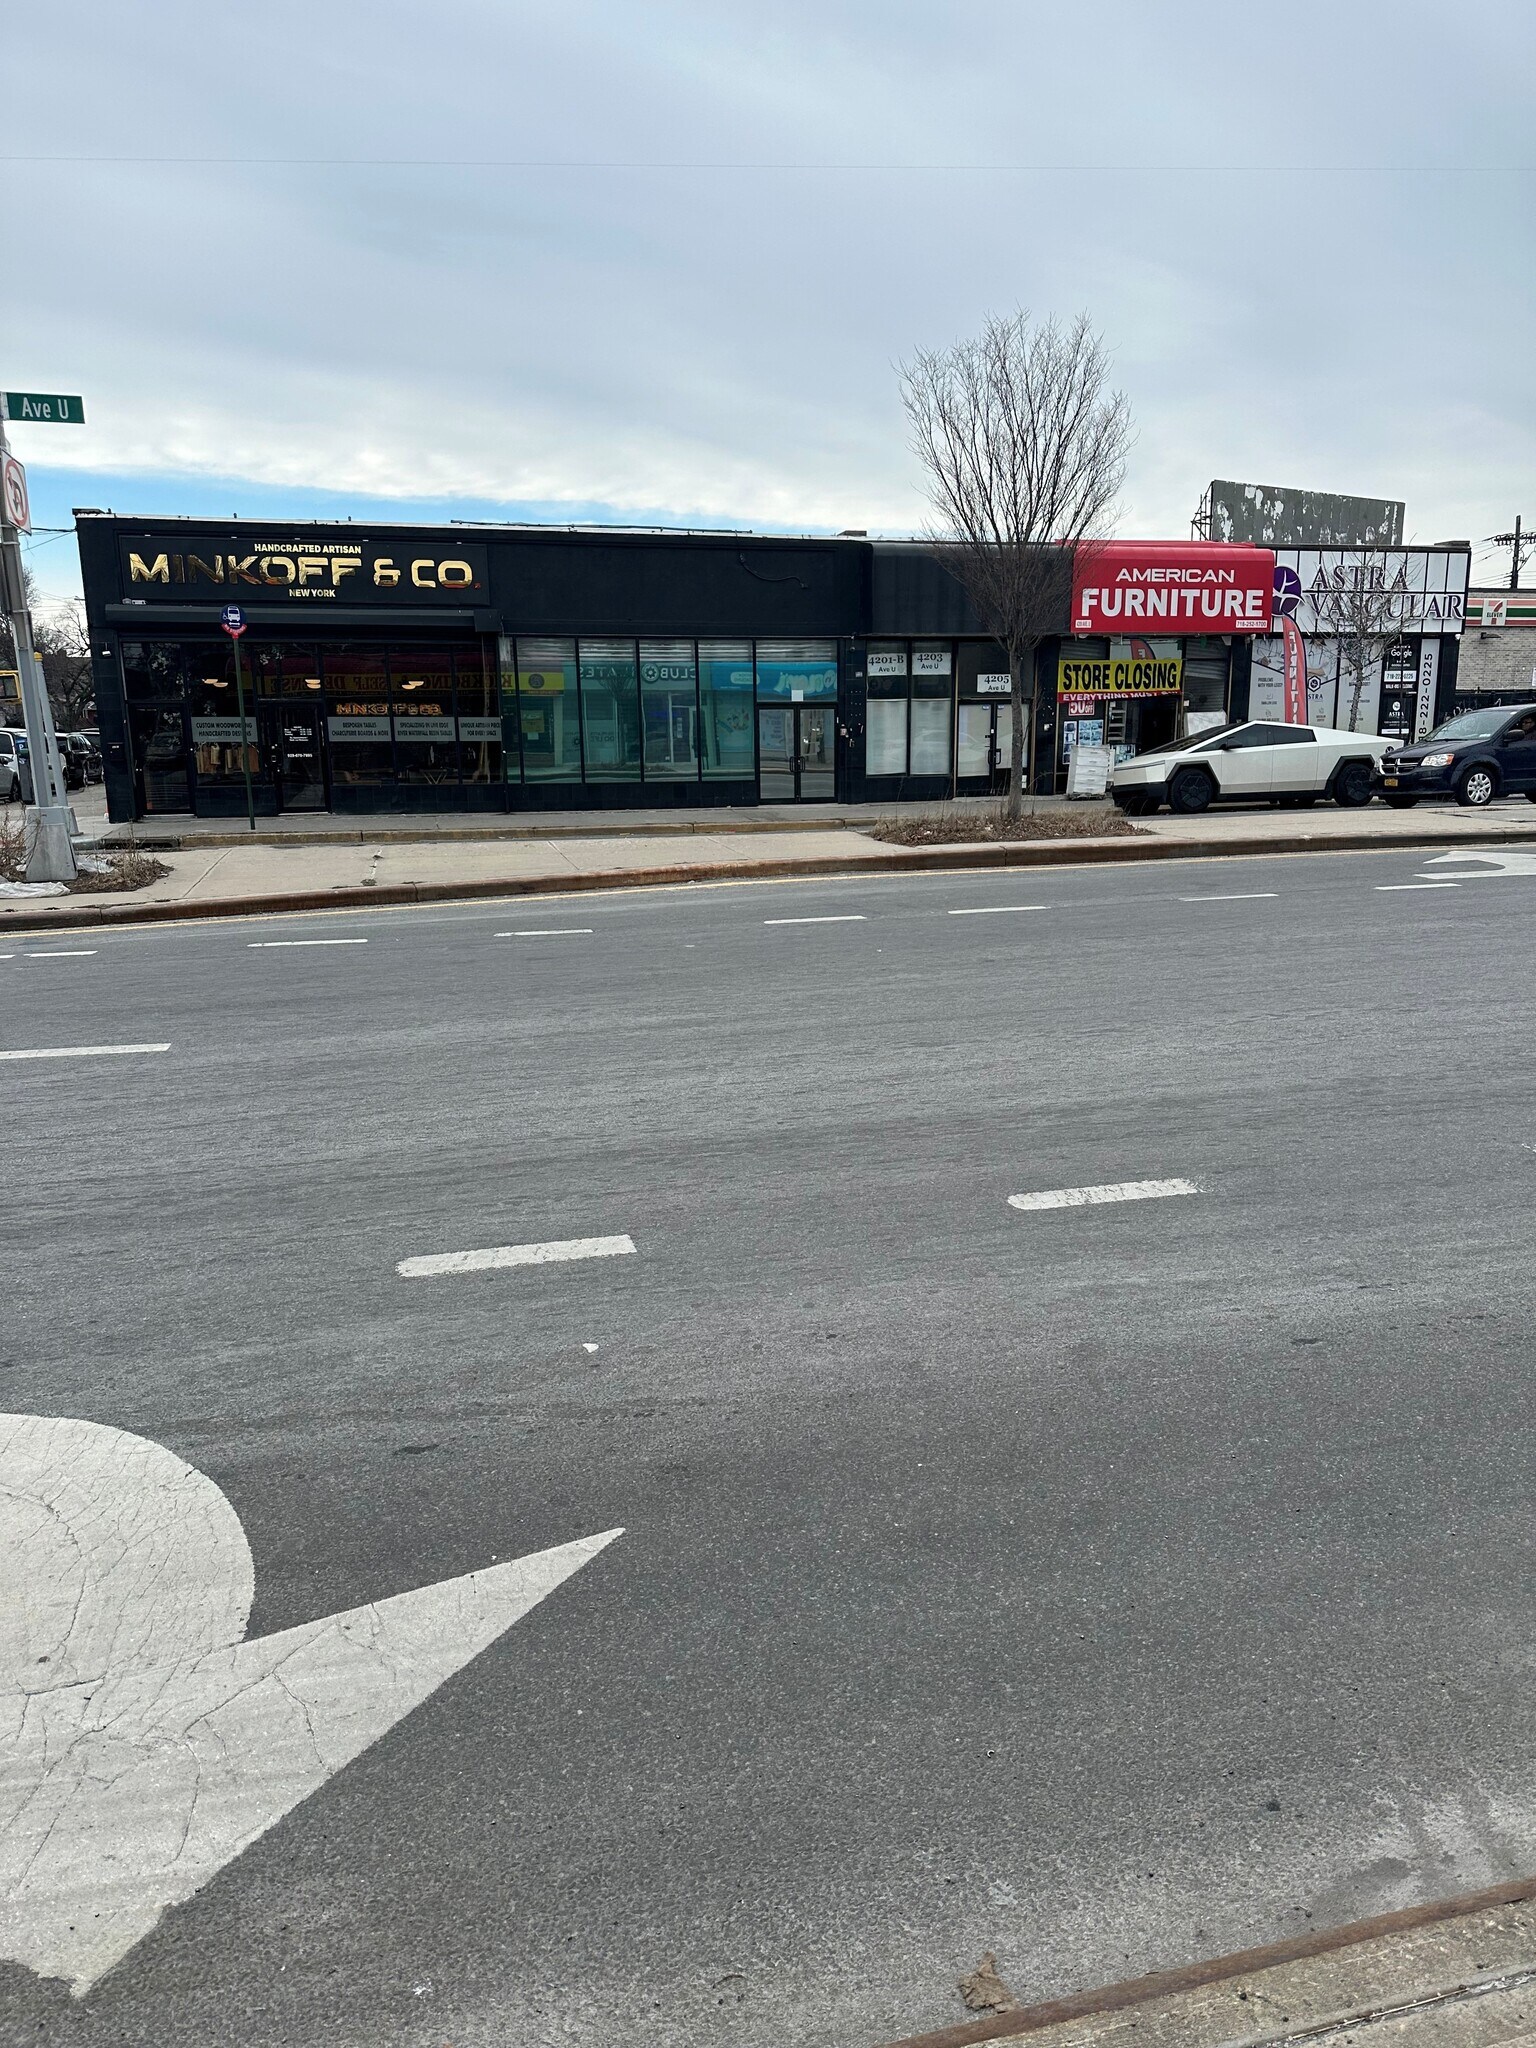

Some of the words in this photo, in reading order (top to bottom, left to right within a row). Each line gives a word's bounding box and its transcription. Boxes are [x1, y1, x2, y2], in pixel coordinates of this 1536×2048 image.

[22, 397, 51, 418] Ave
[58, 398, 69, 419] U
[254, 543, 321, 553] HANDCRAFTED
[322, 545, 362, 554] ARTISAN
[129, 553, 362, 586] MINKOFF
[373, 558, 401, 587] &
[411, 559, 481, 589] CO.
[1115, 568, 1235, 583] AMERICAN
[1310, 564, 1409, 590] ASTRA
[289, 588, 311, 597] NEW
[311, 589, 336, 598] YORK
[1081, 588, 1264, 617] FURNITURE
[1308, 594, 1465, 619] VASCULAR
[868, 655, 904, 665] 4201-B
[917, 653, 943, 663] 4203
[1390, 648, 1412, 658] Gogle
[984, 675, 1010, 684] 4205
[1063, 663, 1111, 690] STORE
[1114, 662, 1177, 690] CLOSING
[1063, 691, 1129, 701] EVERYTHING
[1418, 653, 1433, 741] 18-222-0225
